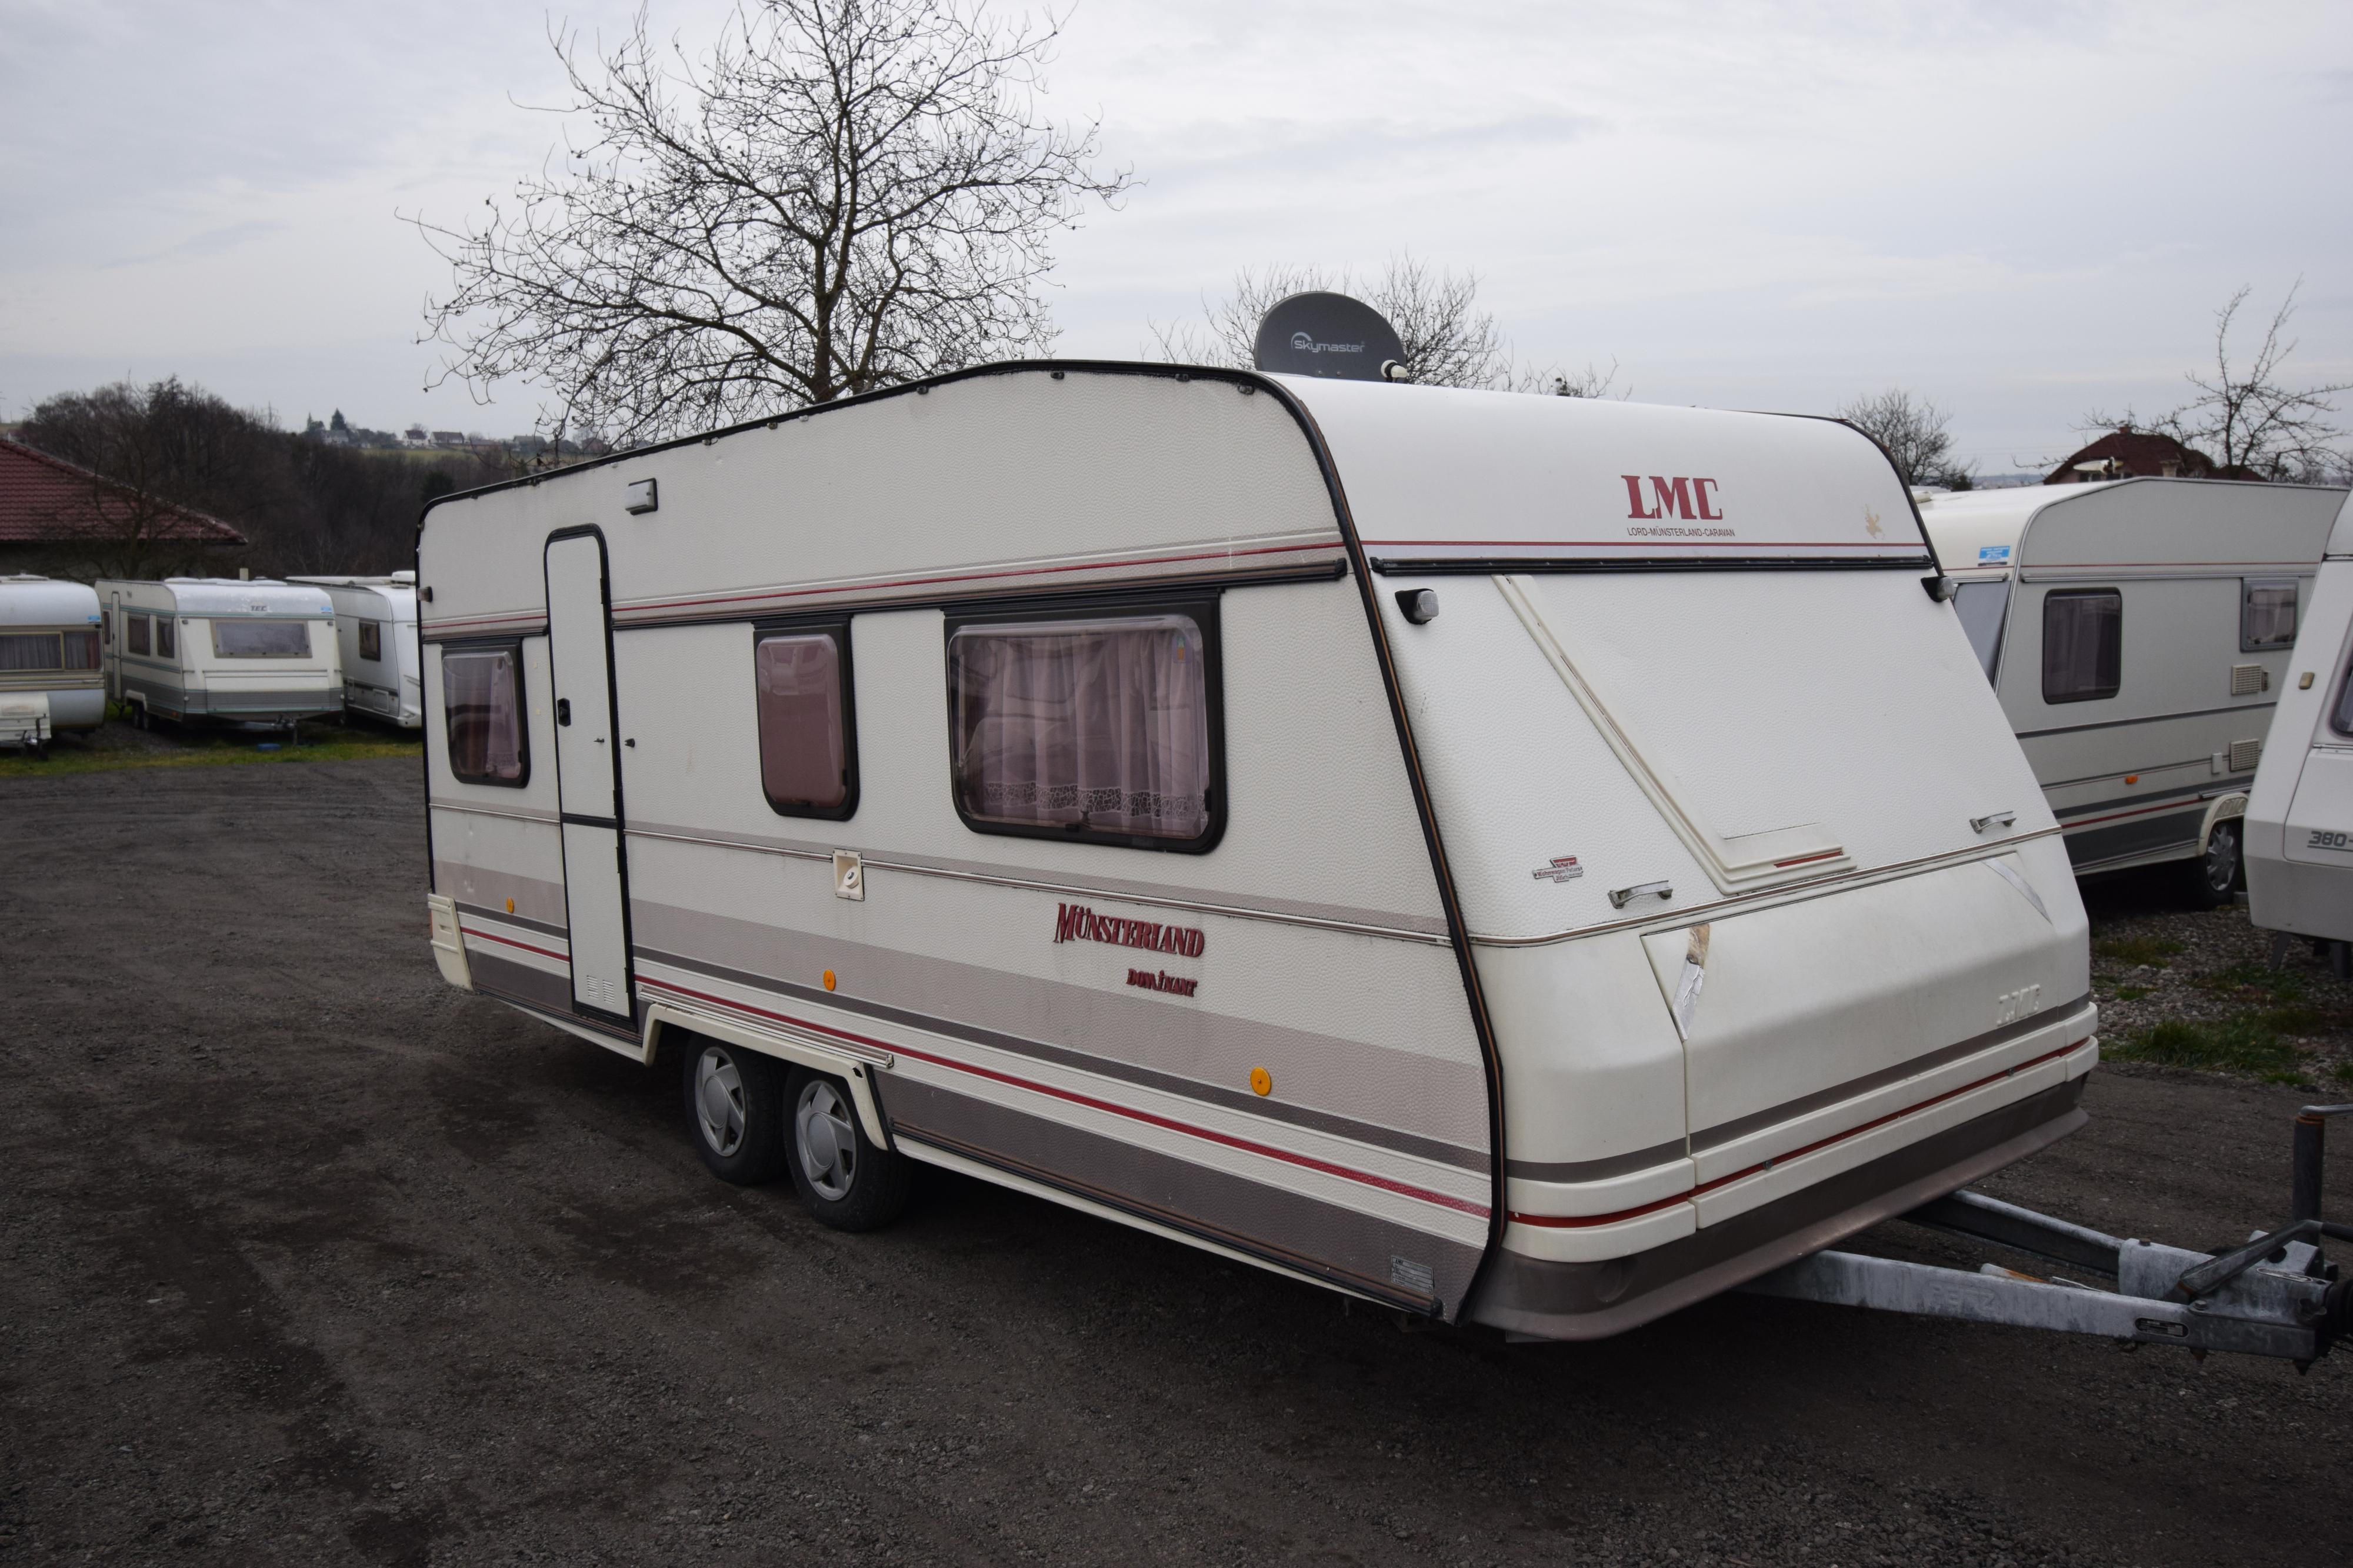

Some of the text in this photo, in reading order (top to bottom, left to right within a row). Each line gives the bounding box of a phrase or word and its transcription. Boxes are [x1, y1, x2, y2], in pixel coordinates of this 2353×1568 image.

[1294, 339, 1365, 353] Skymaster
[1621, 475, 1724, 521] LMC
[1627, 526, 1736, 538] LORD-MÜNSTERLAND-CARAVAN
[1537, 869, 1565, 877] Wohnwagen
[1052, 902, 1205, 958] MÜNSTERLAND
